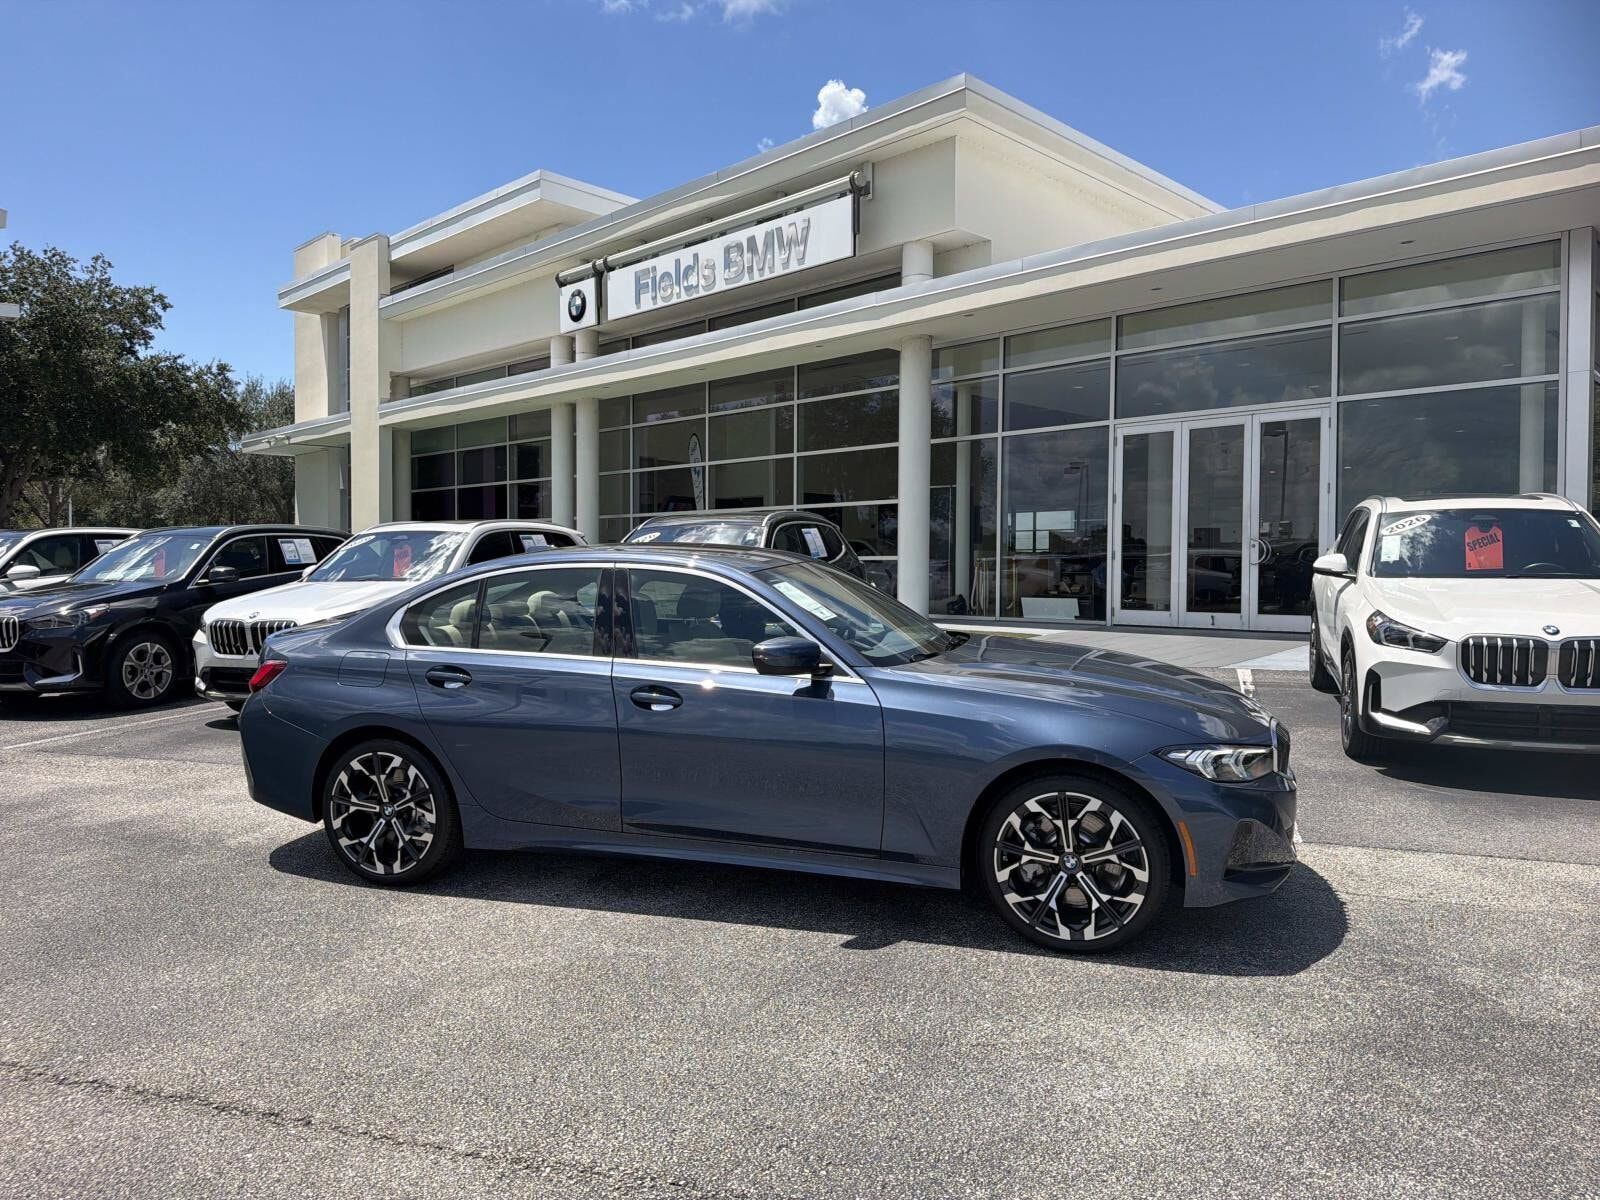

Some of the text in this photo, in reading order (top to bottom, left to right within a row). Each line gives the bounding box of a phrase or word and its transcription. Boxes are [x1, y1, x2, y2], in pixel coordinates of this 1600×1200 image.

[634, 252, 717, 310] Fields
[723, 217, 811, 286] BMW
[1386, 516, 1427, 534] 2026
[1466, 532, 1500, 552] SPECIAL
